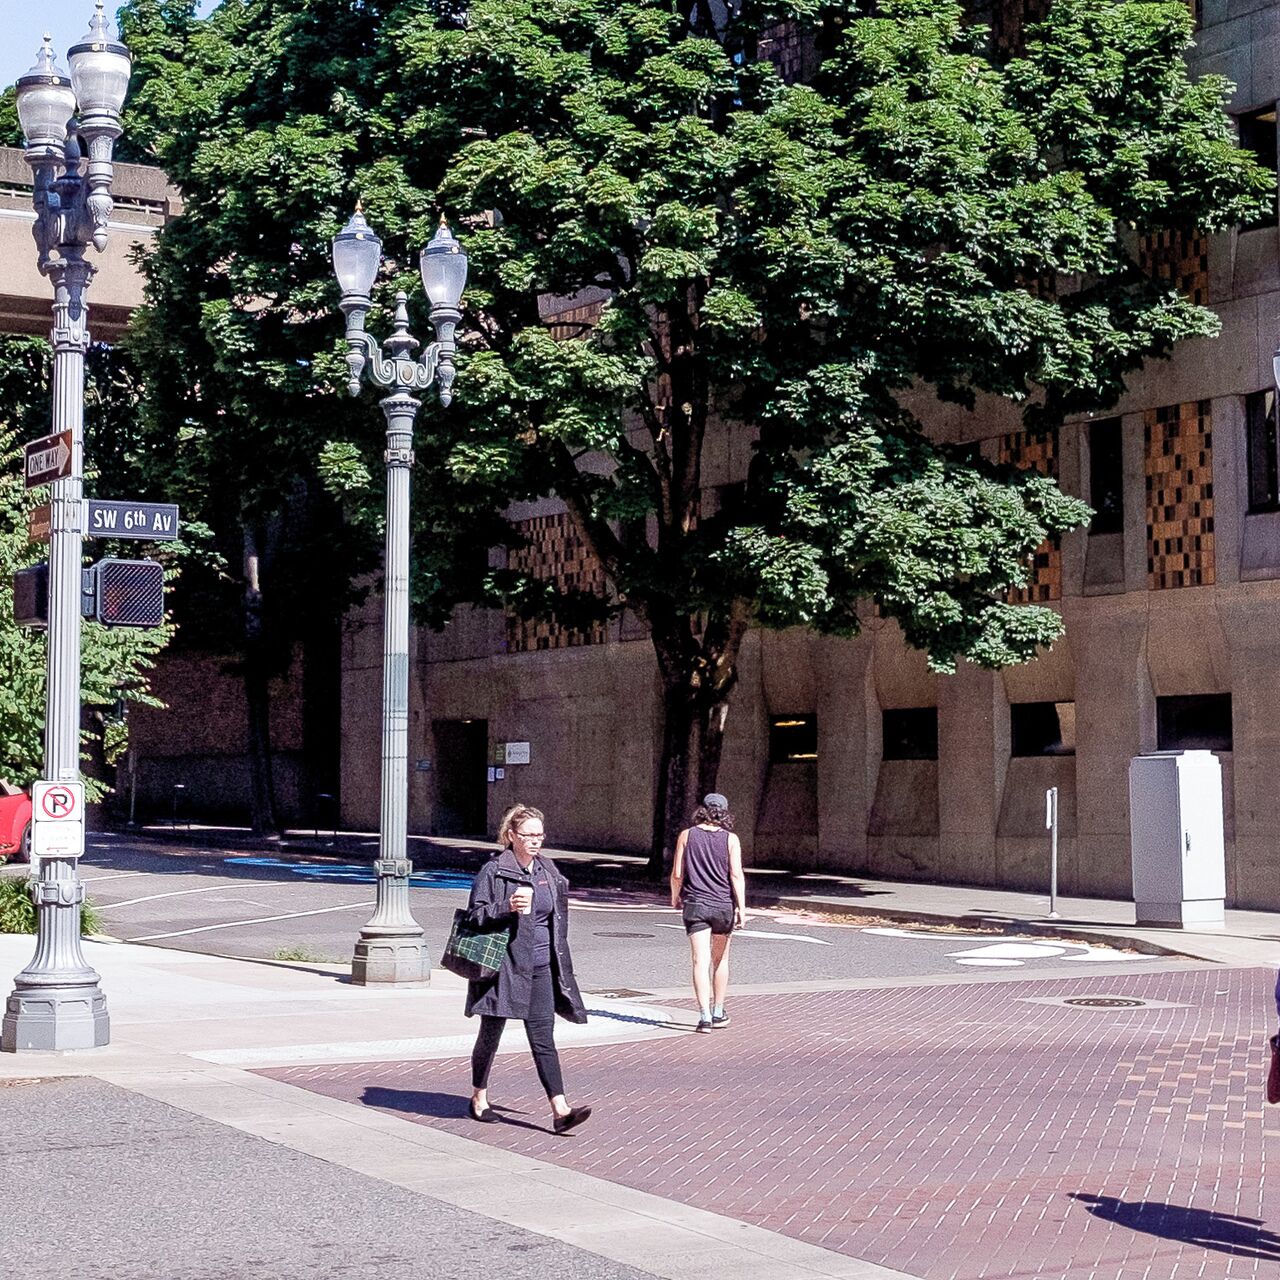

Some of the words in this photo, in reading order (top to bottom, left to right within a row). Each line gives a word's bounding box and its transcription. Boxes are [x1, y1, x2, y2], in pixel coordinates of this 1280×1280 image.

[30, 454, 43, 474] ONE
[45, 448, 59, 469] WAY
[93, 509, 117, 529] SW
[124, 509, 146, 530] 6th
